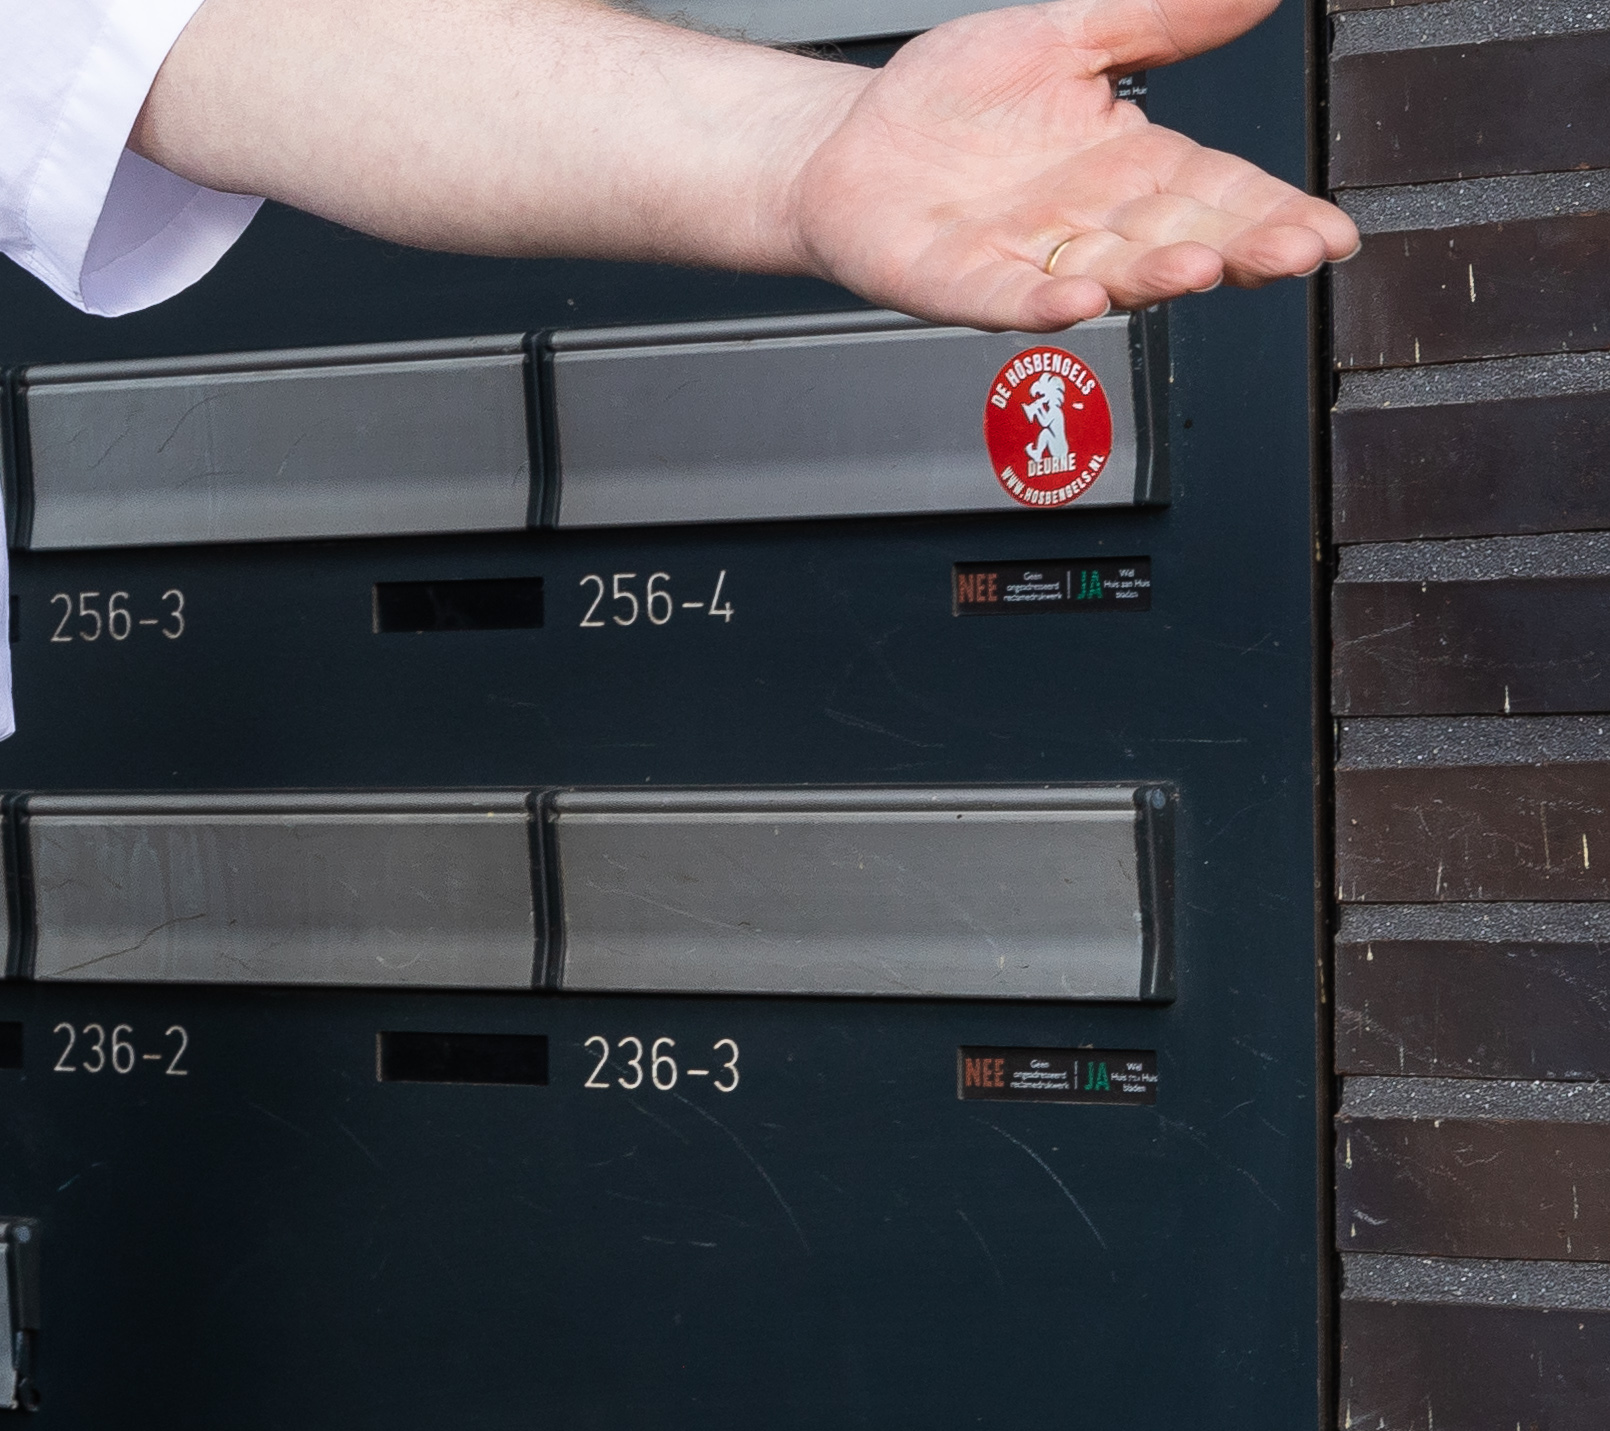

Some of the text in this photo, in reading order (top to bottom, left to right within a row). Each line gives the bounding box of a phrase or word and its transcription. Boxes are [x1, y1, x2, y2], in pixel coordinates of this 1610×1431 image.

[990, 382, 1012, 410] DE
[1027, 452, 1077, 478] DEURNE
[579, 569, 734, 627] 256-4
[958, 572, 998, 603] NEE
[1077, 570, 1103, 600] JA
[50, 589, 185, 642] 256-3
[53, 1022, 188, 1076] 236-2
[584, 1035, 740, 1093] 236-3
[965, 1057, 1005, 1088] NEE
[1084, 1061, 1110, 1091] JA
